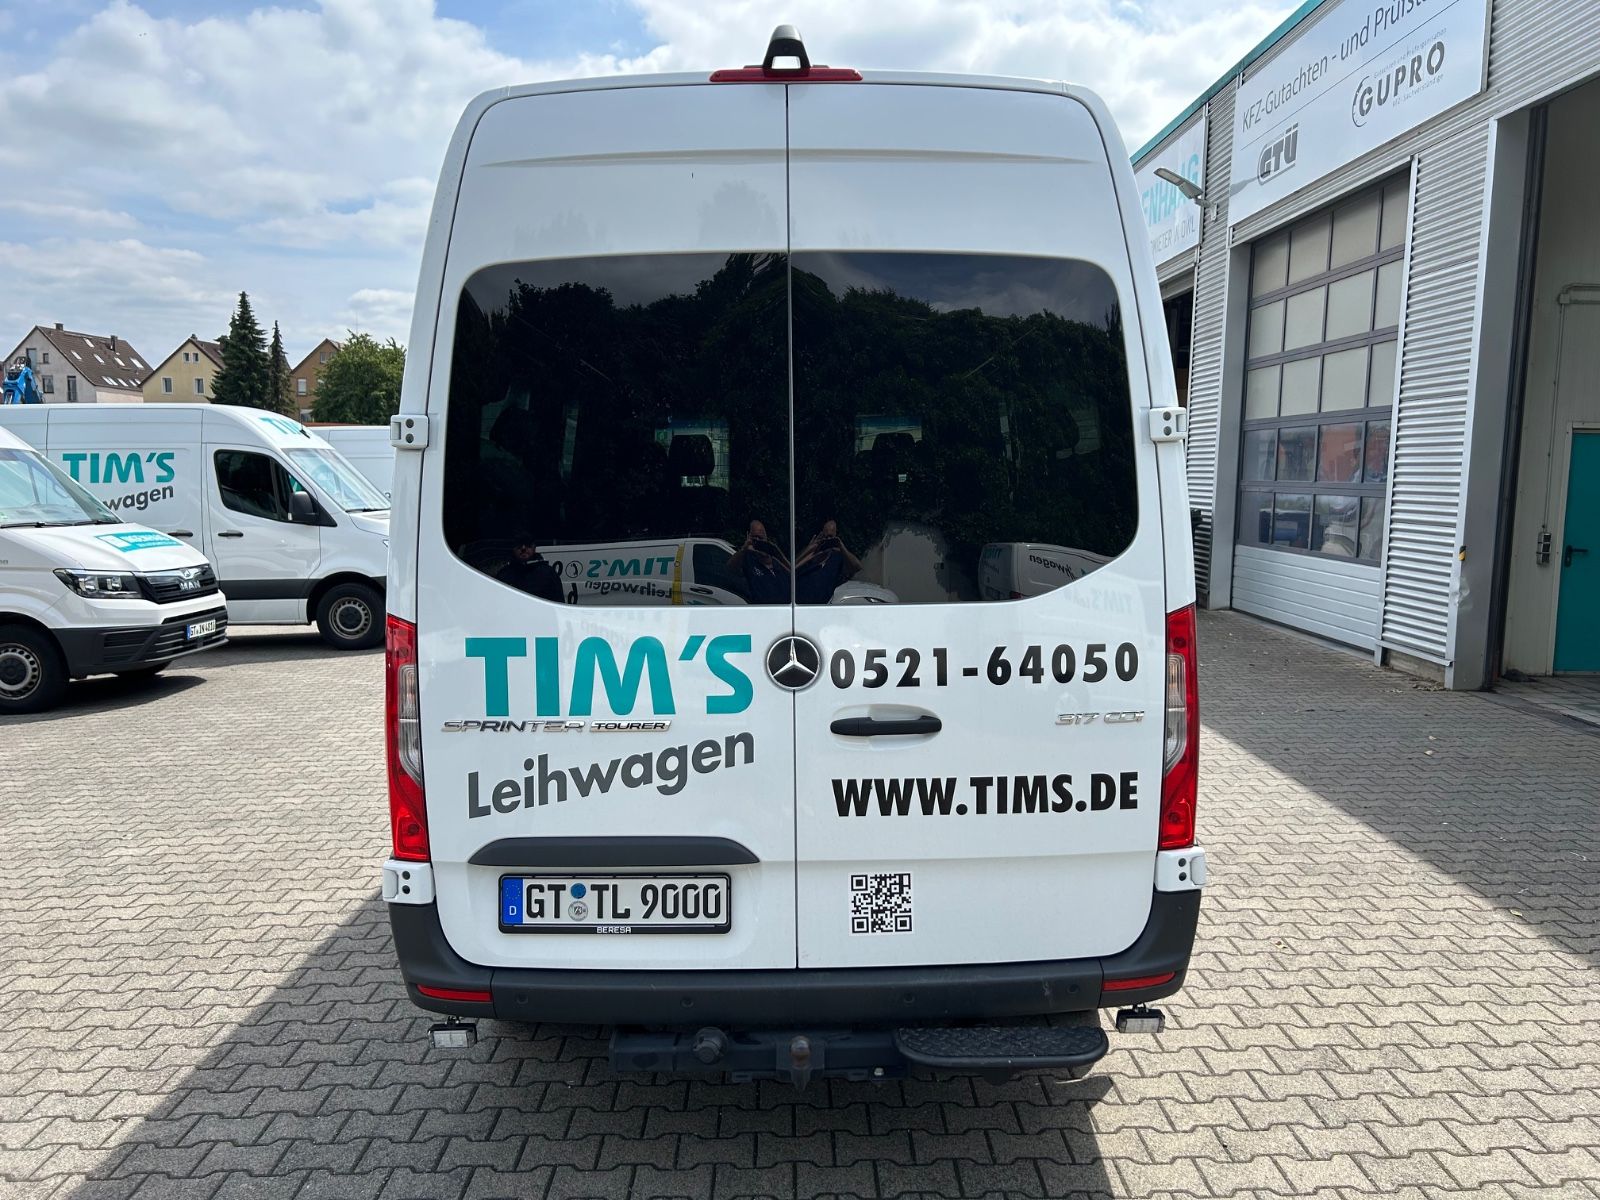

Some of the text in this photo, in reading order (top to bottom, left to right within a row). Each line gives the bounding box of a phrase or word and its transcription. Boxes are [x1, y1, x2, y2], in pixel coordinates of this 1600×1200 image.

[1243, 55, 1328, 132] KFZ-Gutachten
[1340, 15, 1370, 60] und
[1359, 41, 1445, 117] GUPRO
[1260, 123, 1298, 180] GTÜ
[180, 580, 201, 591] MAN
[464, 634, 754, 717] TIM'S
[830, 642, 1139, 690] 0521-64050
[441, 720, 669, 733] SPRINTER TOURER
[1055, 710, 1145, 726] 317 CDI
[467, 731, 755, 819] Leihwagen
[831, 772, 1139, 817] WWW.TIMS.DE
[508, 905, 517, 916] D
[526, 884, 567, 919] GT
[590, 884, 631, 919] TL
[640, 884, 721, 919] 9000
[596, 926, 632, 934] BERESA
